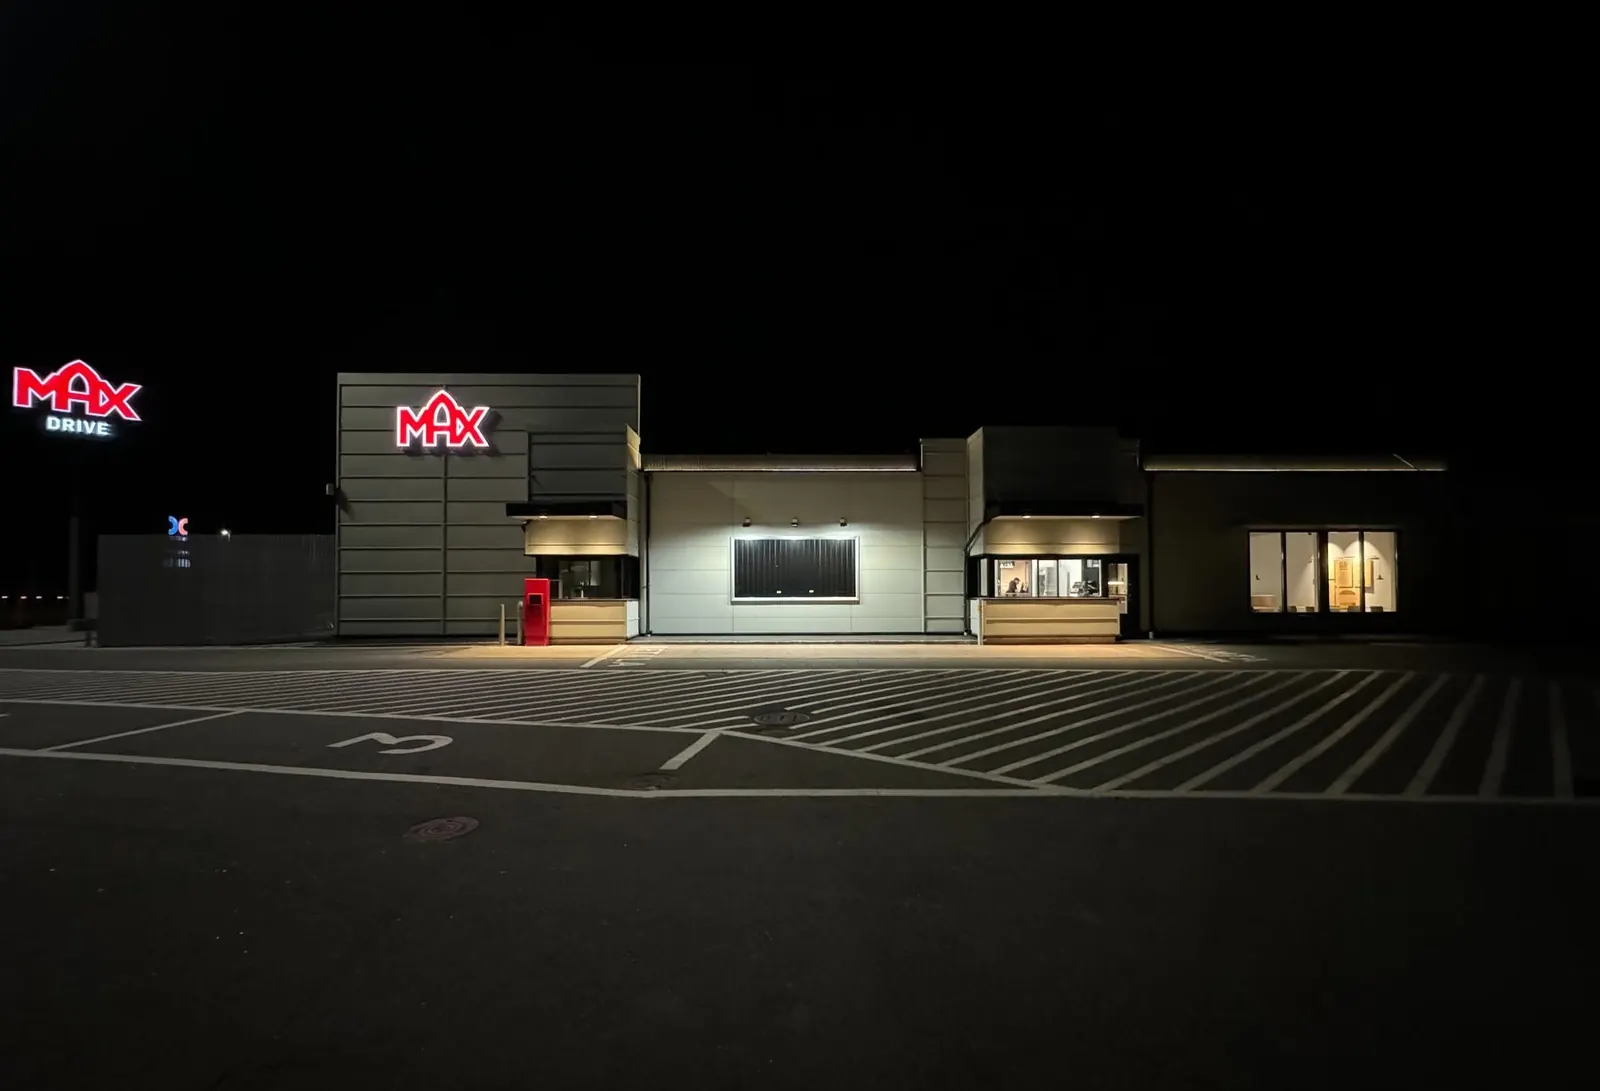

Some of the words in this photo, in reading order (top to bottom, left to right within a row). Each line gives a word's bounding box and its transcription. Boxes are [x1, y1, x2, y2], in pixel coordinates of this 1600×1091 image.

[13, 359, 142, 421] MAX
[45, 415, 112, 436] DRIVE
[396, 389, 490, 447] MAX
[326, 732, 454, 755] 3
